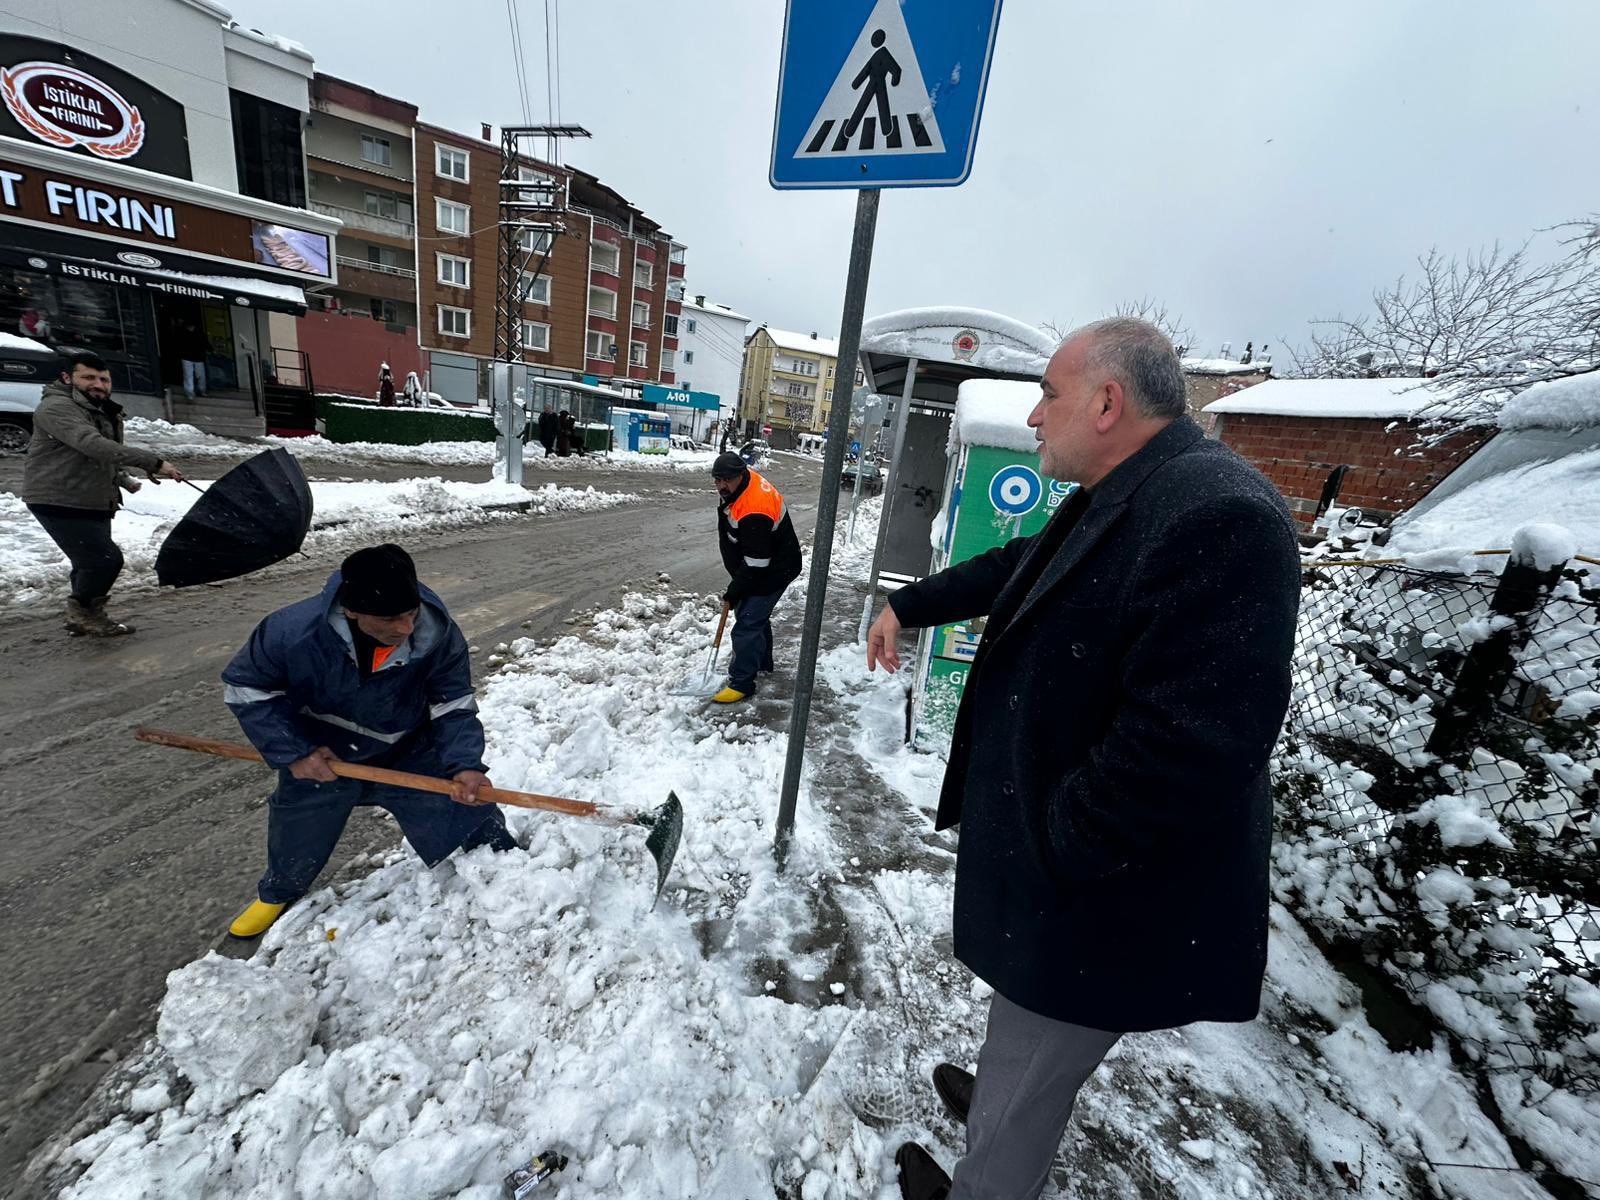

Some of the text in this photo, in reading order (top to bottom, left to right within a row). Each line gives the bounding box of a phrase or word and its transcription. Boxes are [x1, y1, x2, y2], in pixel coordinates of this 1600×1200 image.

[43, 82, 104, 116] İSTİKLAL
[57, 107, 97, 130] FIRINI
[45, 180, 176, 239] FIRINI
[62, 262, 207, 299] İSTİKLAL FIRINI
